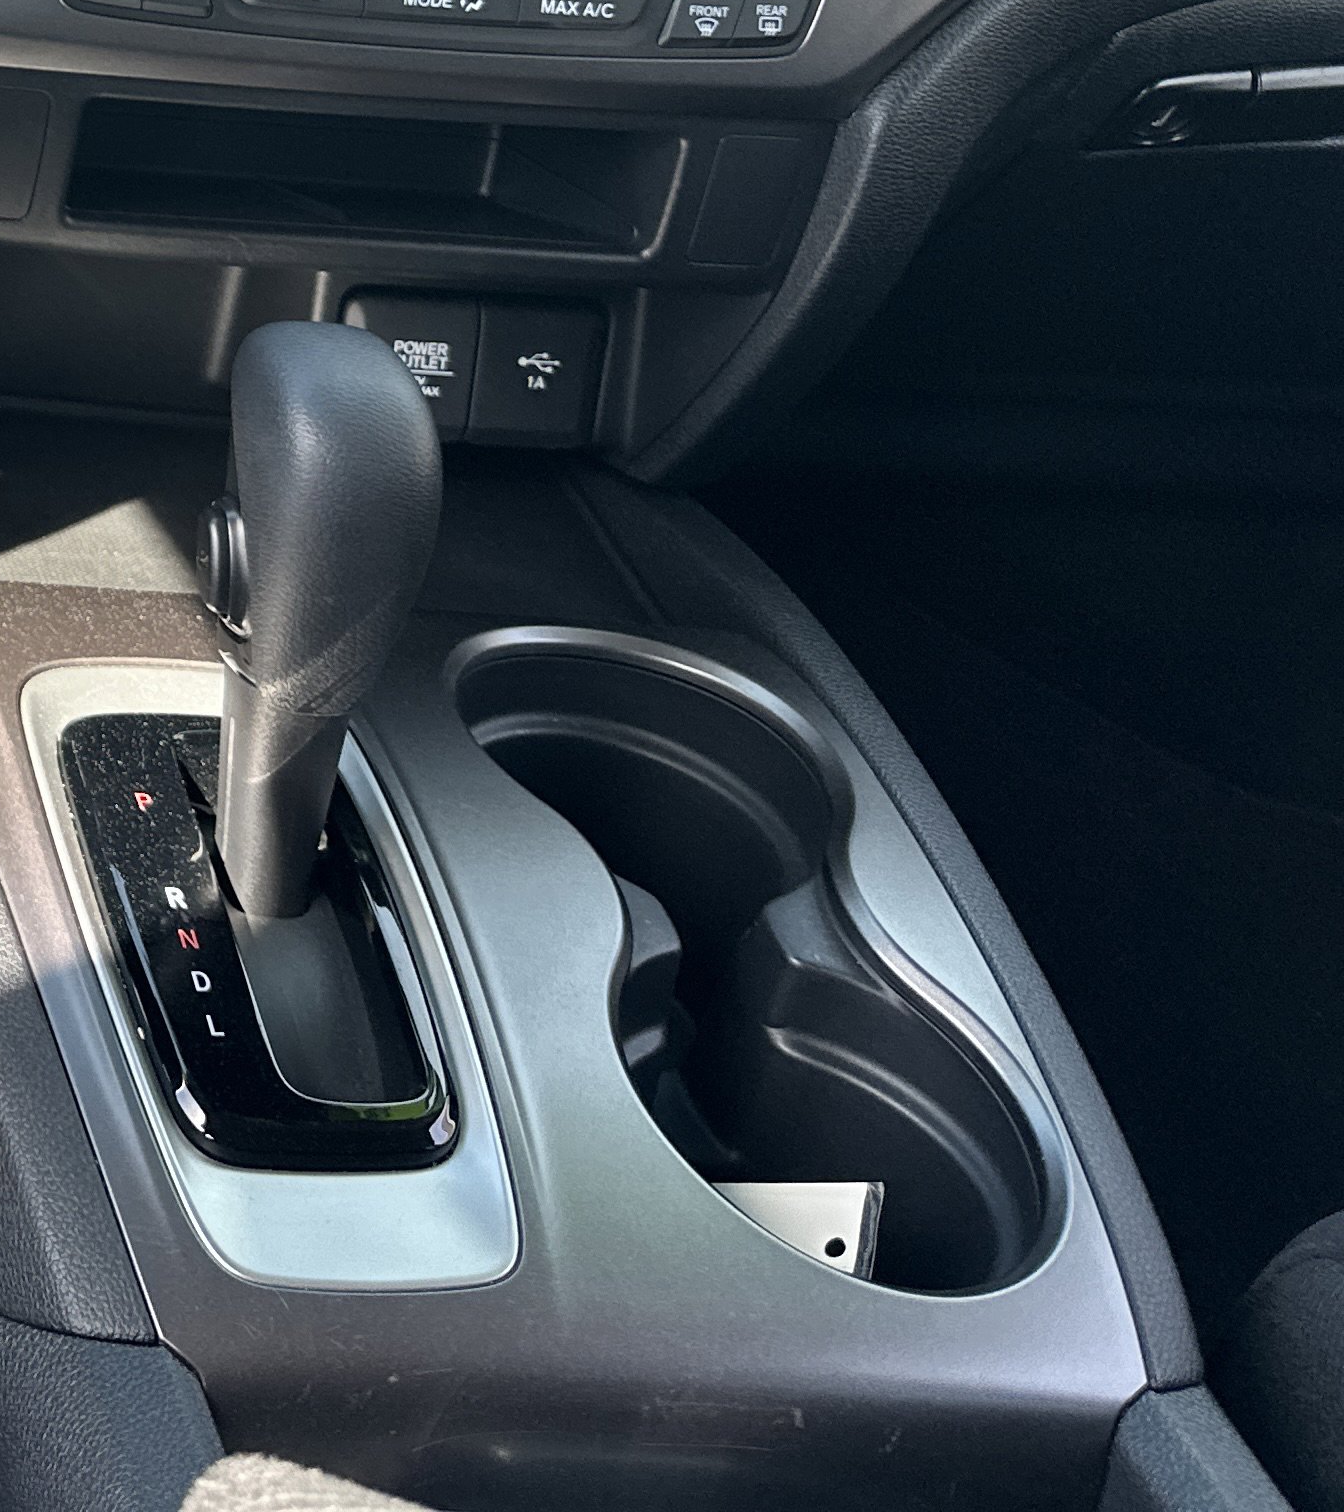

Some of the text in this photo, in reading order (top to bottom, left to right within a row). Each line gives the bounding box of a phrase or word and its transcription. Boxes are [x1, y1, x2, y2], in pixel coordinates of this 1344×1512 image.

[582, 1, 615, 20] A/C
[688, 4, 730, 19] FRONT
[756, 4, 788, 18] REAR
[393, 339, 449, 356] POWER
[527, 375, 546, 390] 1A
[134, 791, 153, 813] P
[164, 885, 188, 910] R
[178, 928, 200, 950] N
[191, 969, 211, 992] D
[205, 1014, 225, 1037] L
